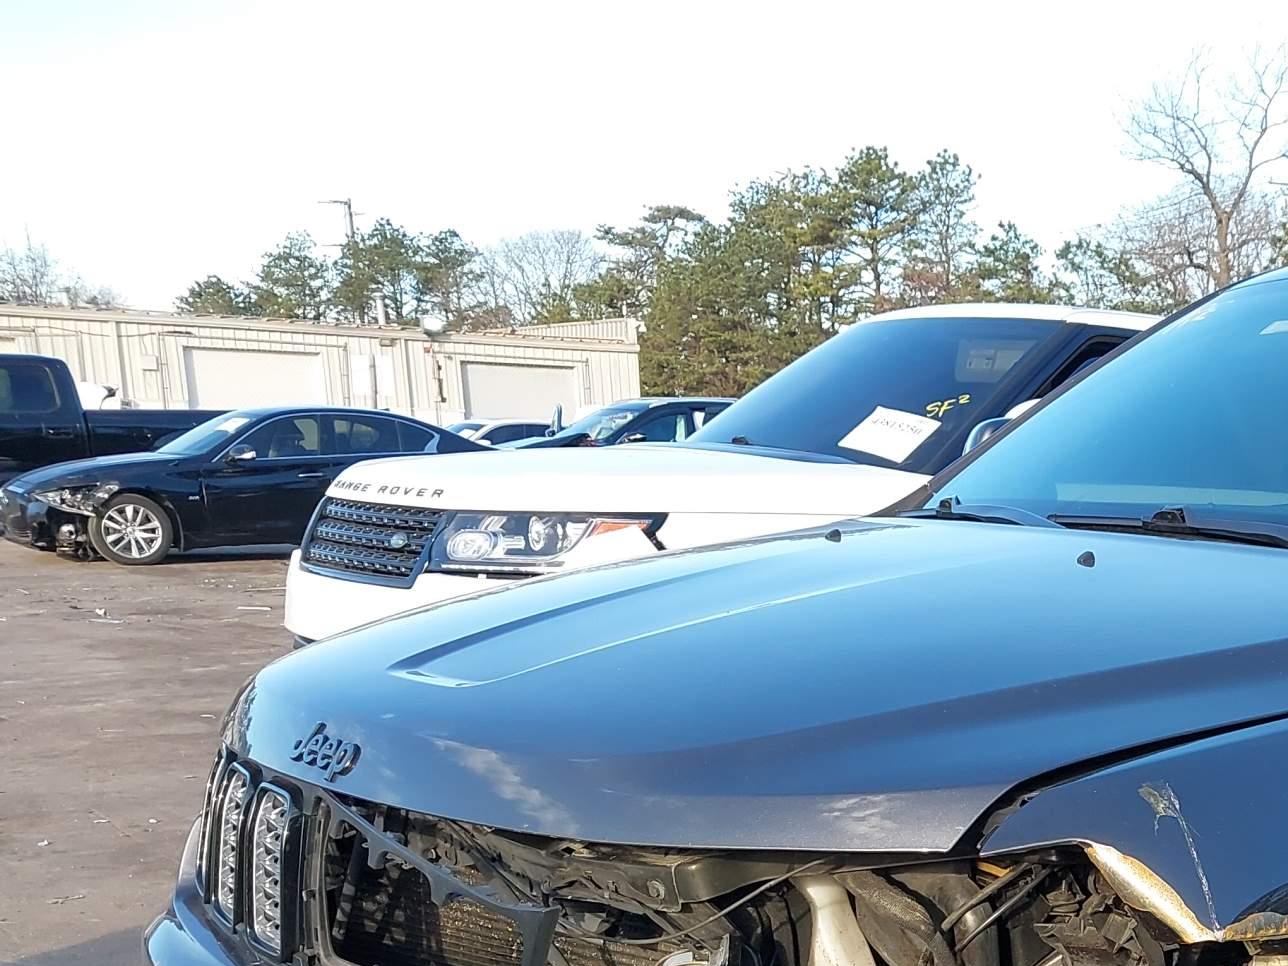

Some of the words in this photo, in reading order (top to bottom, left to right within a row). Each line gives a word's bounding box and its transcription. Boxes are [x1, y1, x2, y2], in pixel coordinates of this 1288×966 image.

[334, 480, 371, 492] RANGE
[377, 485, 444, 498] ROVER
[289, 721, 362, 783] Jeep
